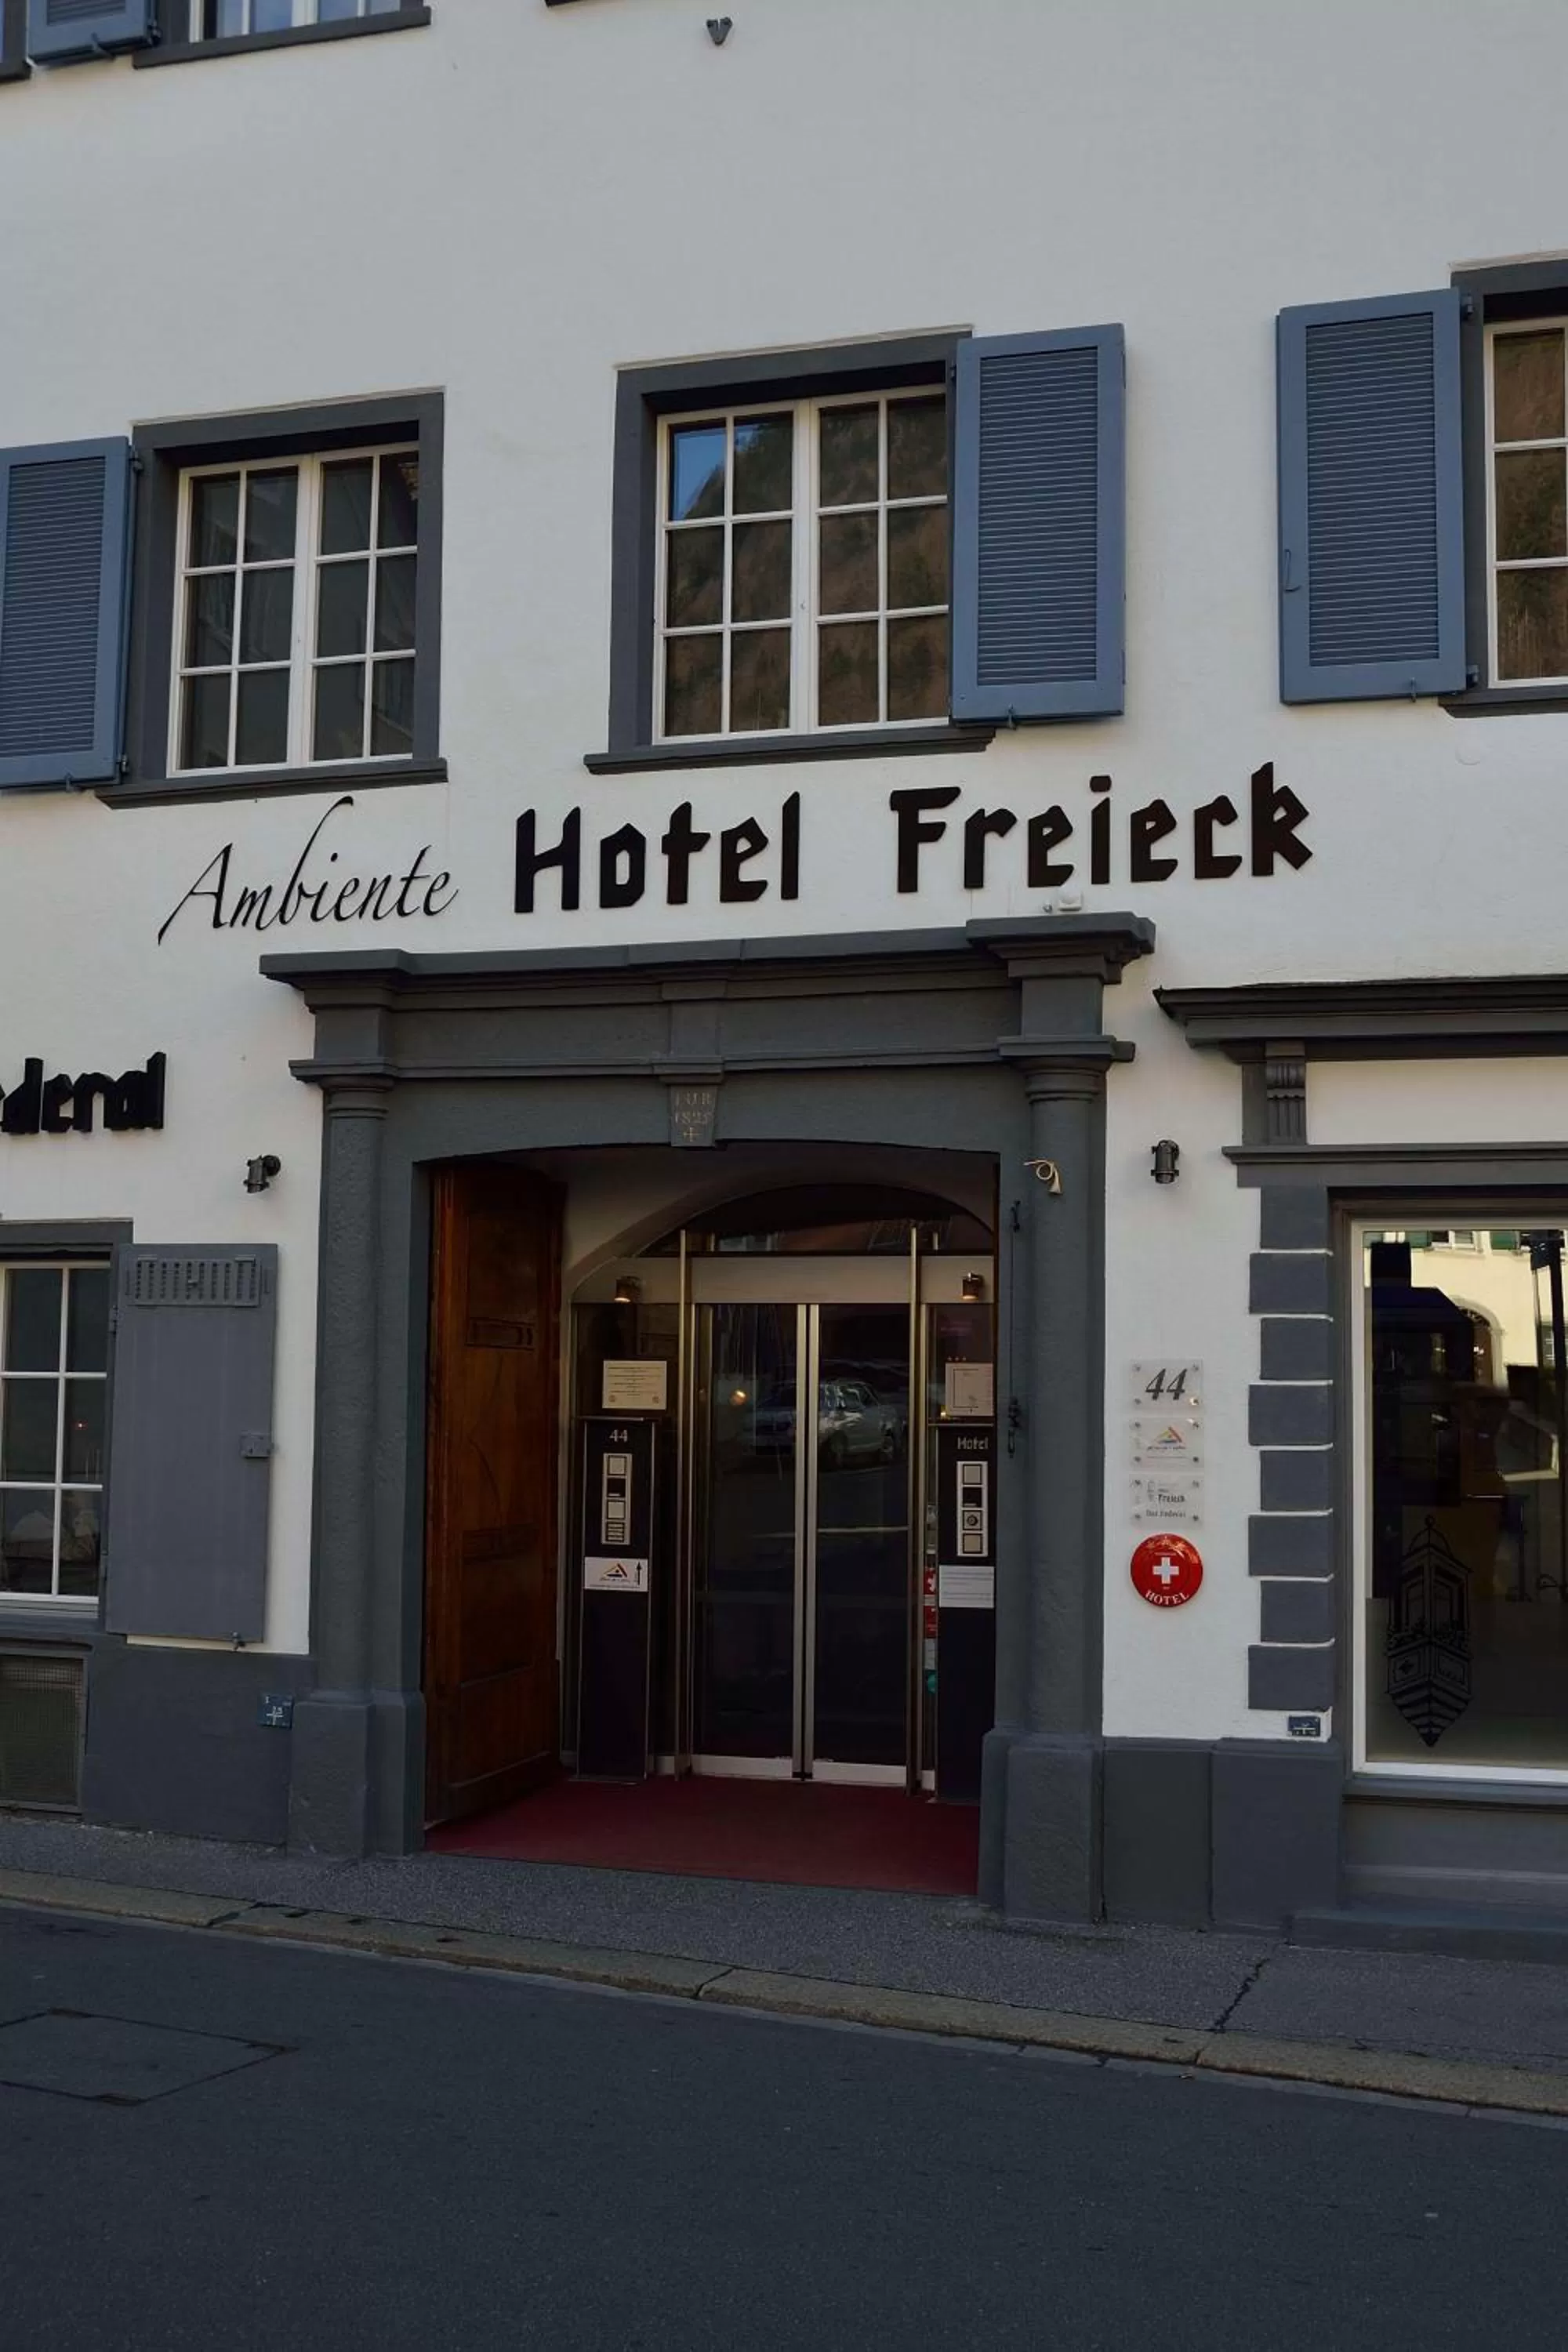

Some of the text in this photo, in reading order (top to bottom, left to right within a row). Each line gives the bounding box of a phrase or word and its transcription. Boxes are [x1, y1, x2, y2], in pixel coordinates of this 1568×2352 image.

[158, 761, 1313, 946] Ambiente Hotel Freieck
[1145, 1368, 1188, 1400] 44
[609, 1429, 628, 1442] 44
[957, 1436, 989, 1450] Hotel
[1145, 1589, 1190, 1605] HOTEL
